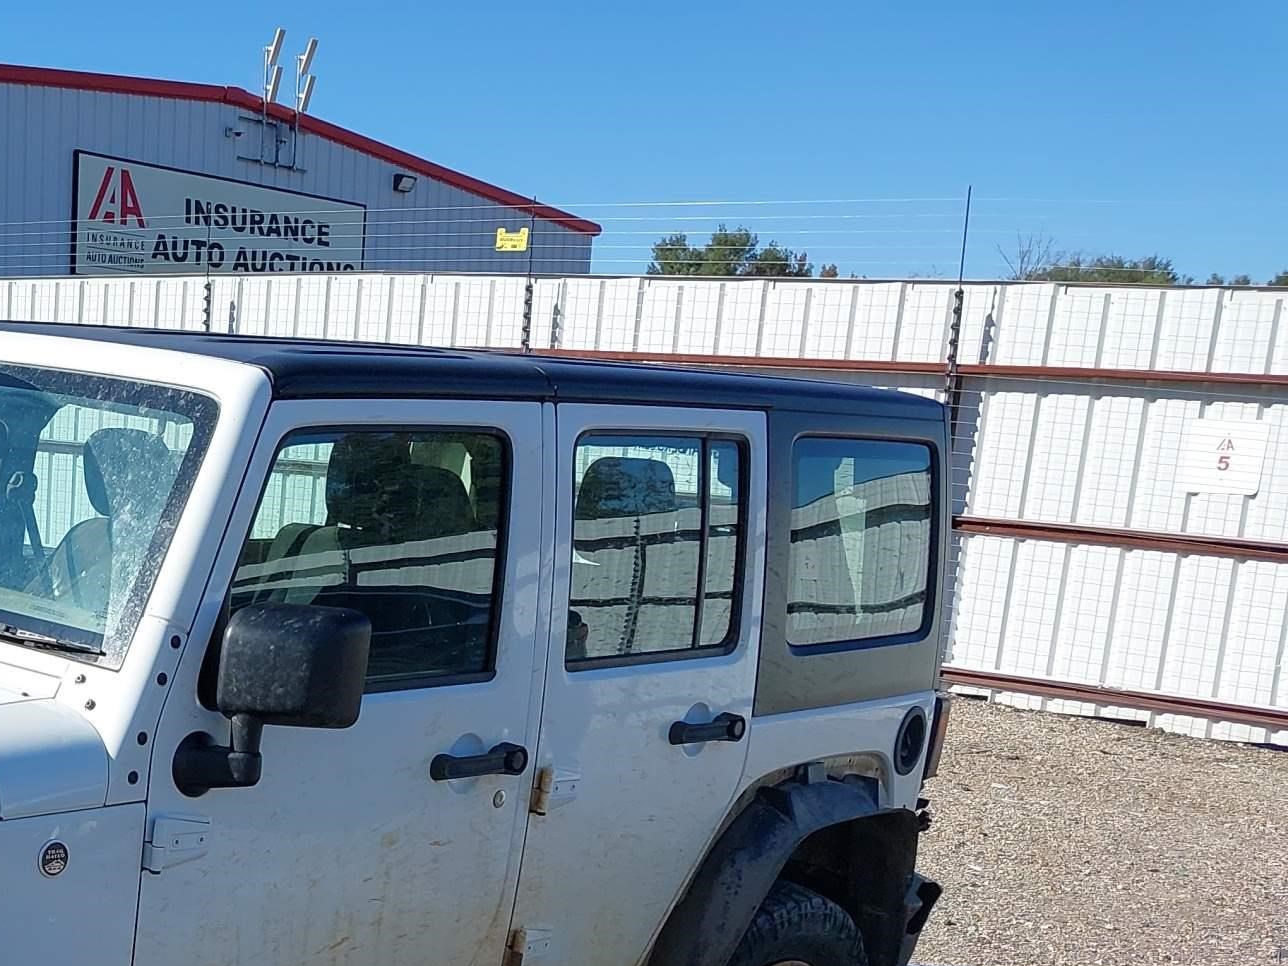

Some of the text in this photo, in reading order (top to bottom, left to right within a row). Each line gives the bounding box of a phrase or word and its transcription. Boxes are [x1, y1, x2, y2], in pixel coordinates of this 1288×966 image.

[185, 198, 330, 247] INSURANCE
[86, 231, 146, 251] INSURANCE
[86, 250, 107, 264] AUTO
[151, 234, 355, 273] AUTO AUCTIO
[1216, 456, 1232, 471] 5
